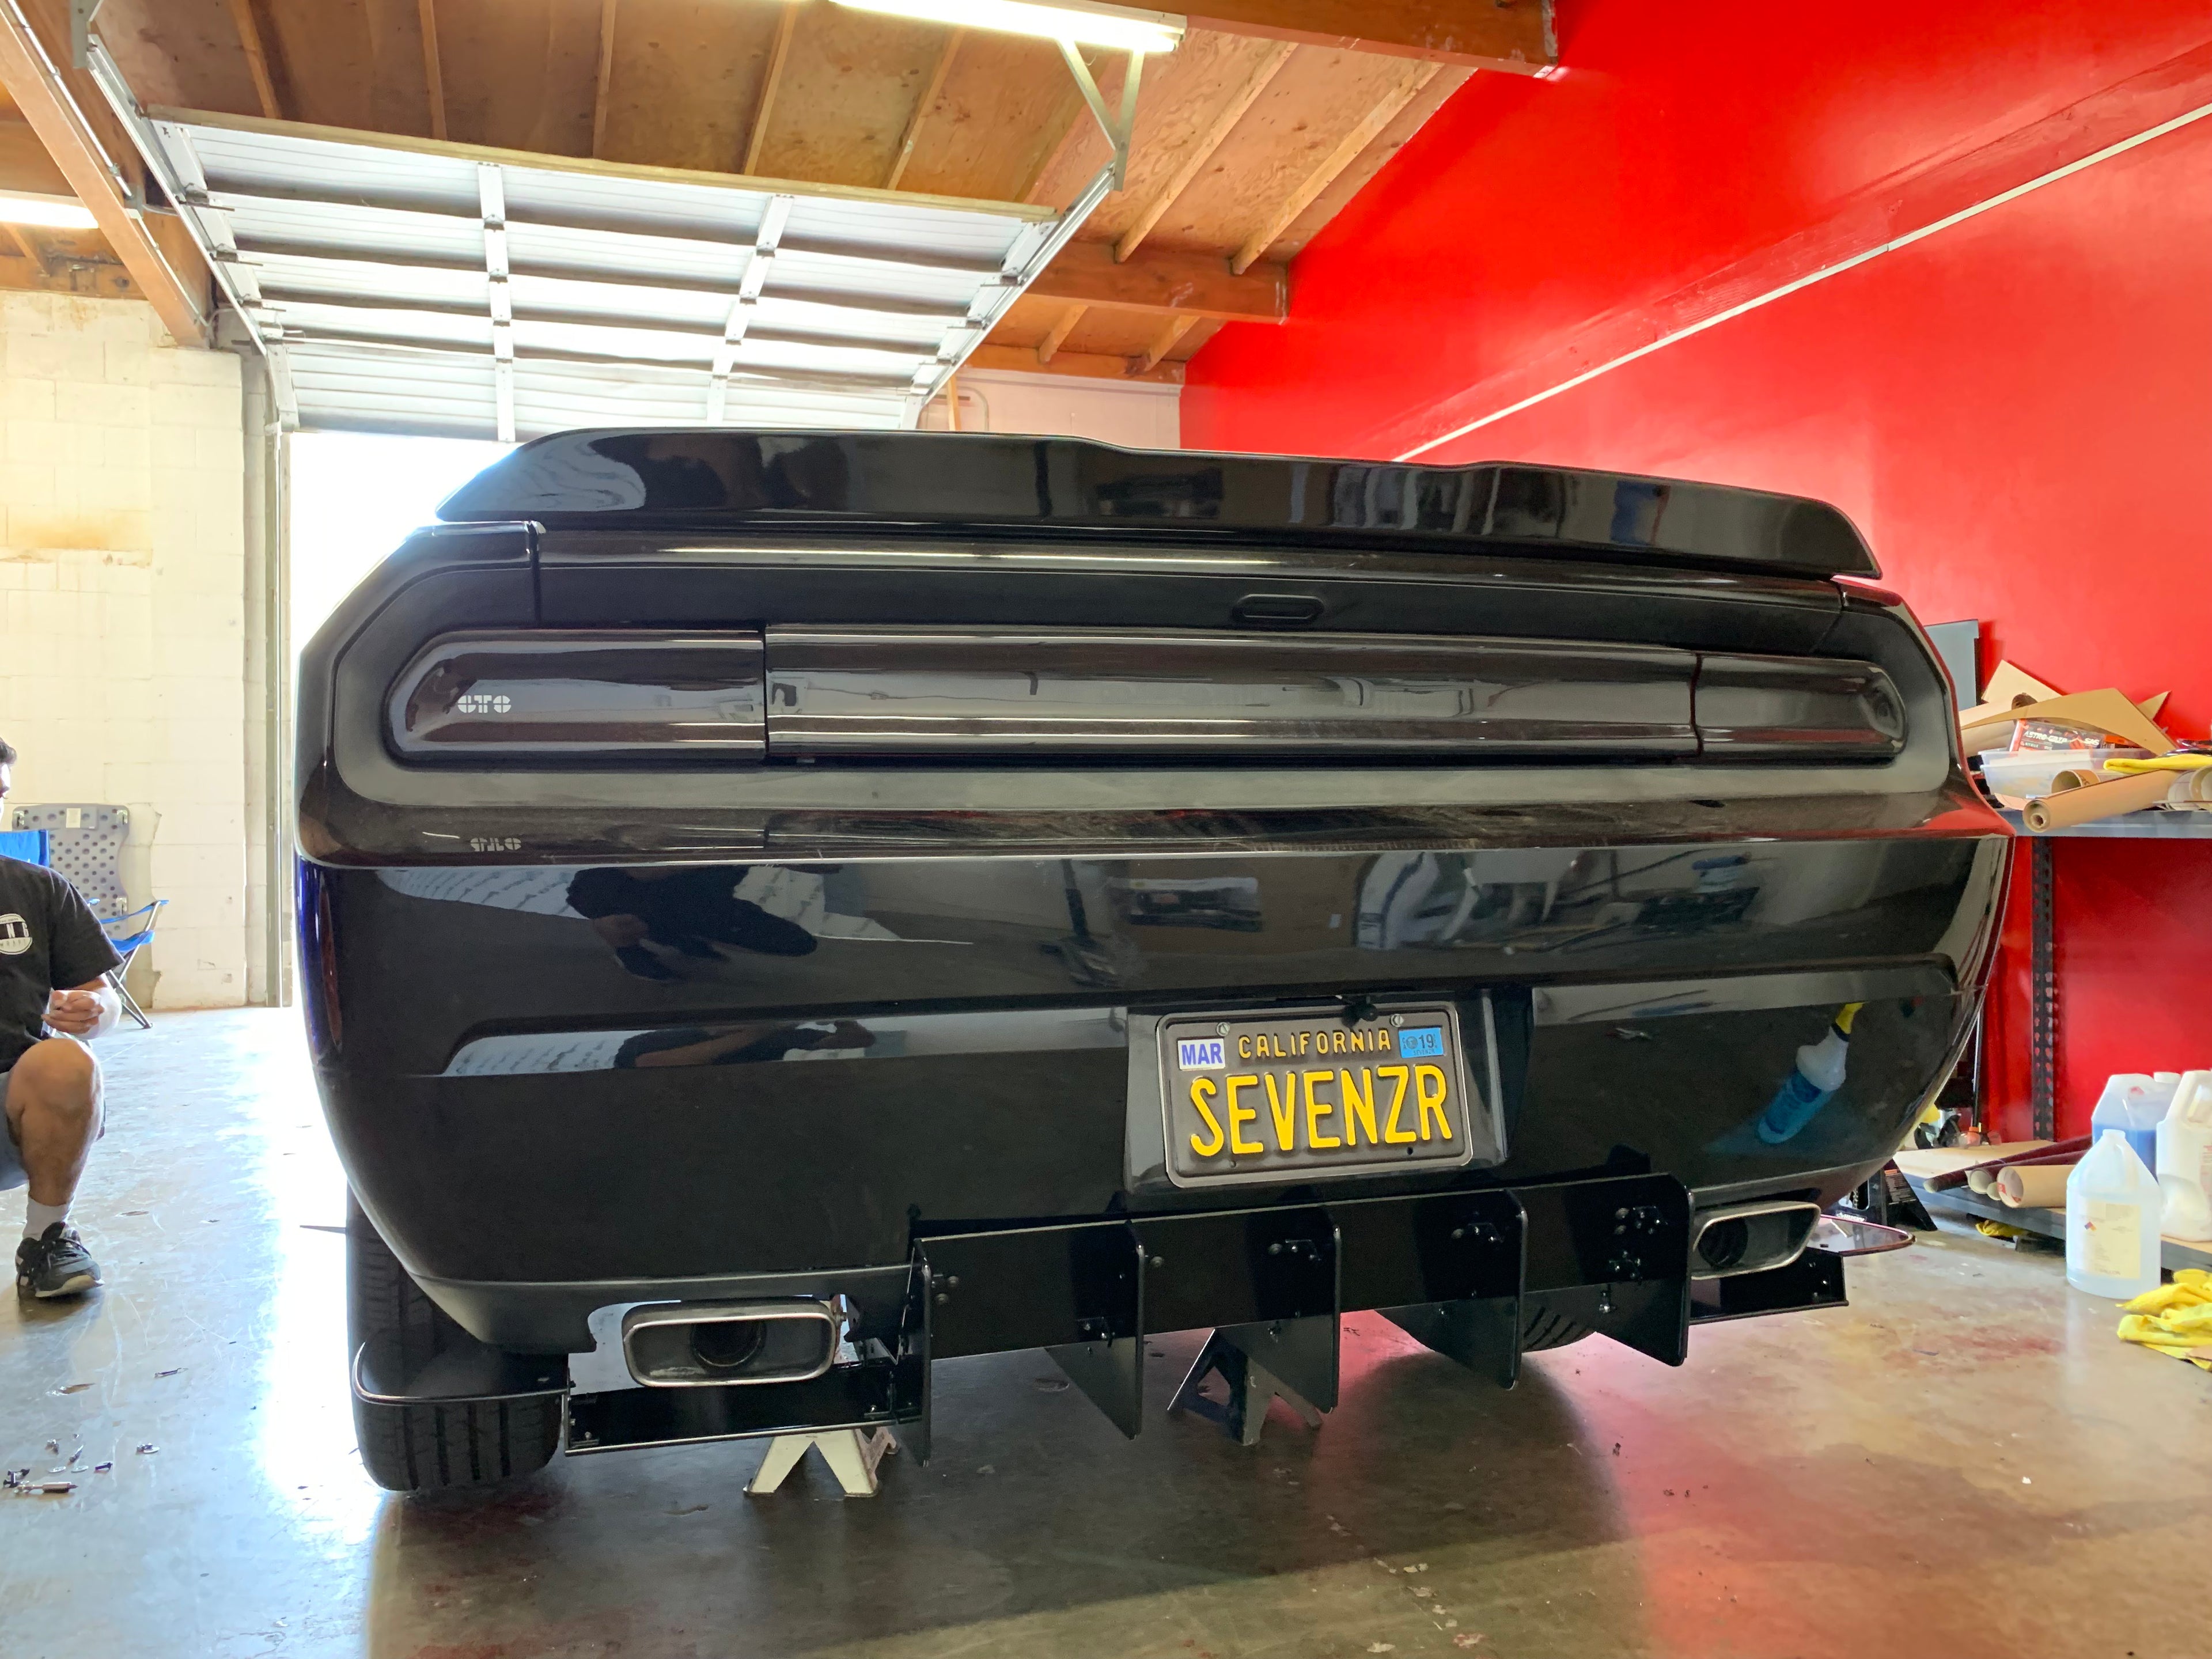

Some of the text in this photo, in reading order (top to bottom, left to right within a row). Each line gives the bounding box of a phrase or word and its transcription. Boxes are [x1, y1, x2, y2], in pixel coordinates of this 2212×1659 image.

[1181, 1042, 1224, 1066] MAR
[1238, 1029, 1391, 1059] CALIFORNIA
[1418, 1033, 1434, 1049] 19
[1190, 1064, 1452, 1156] SEVENZR
